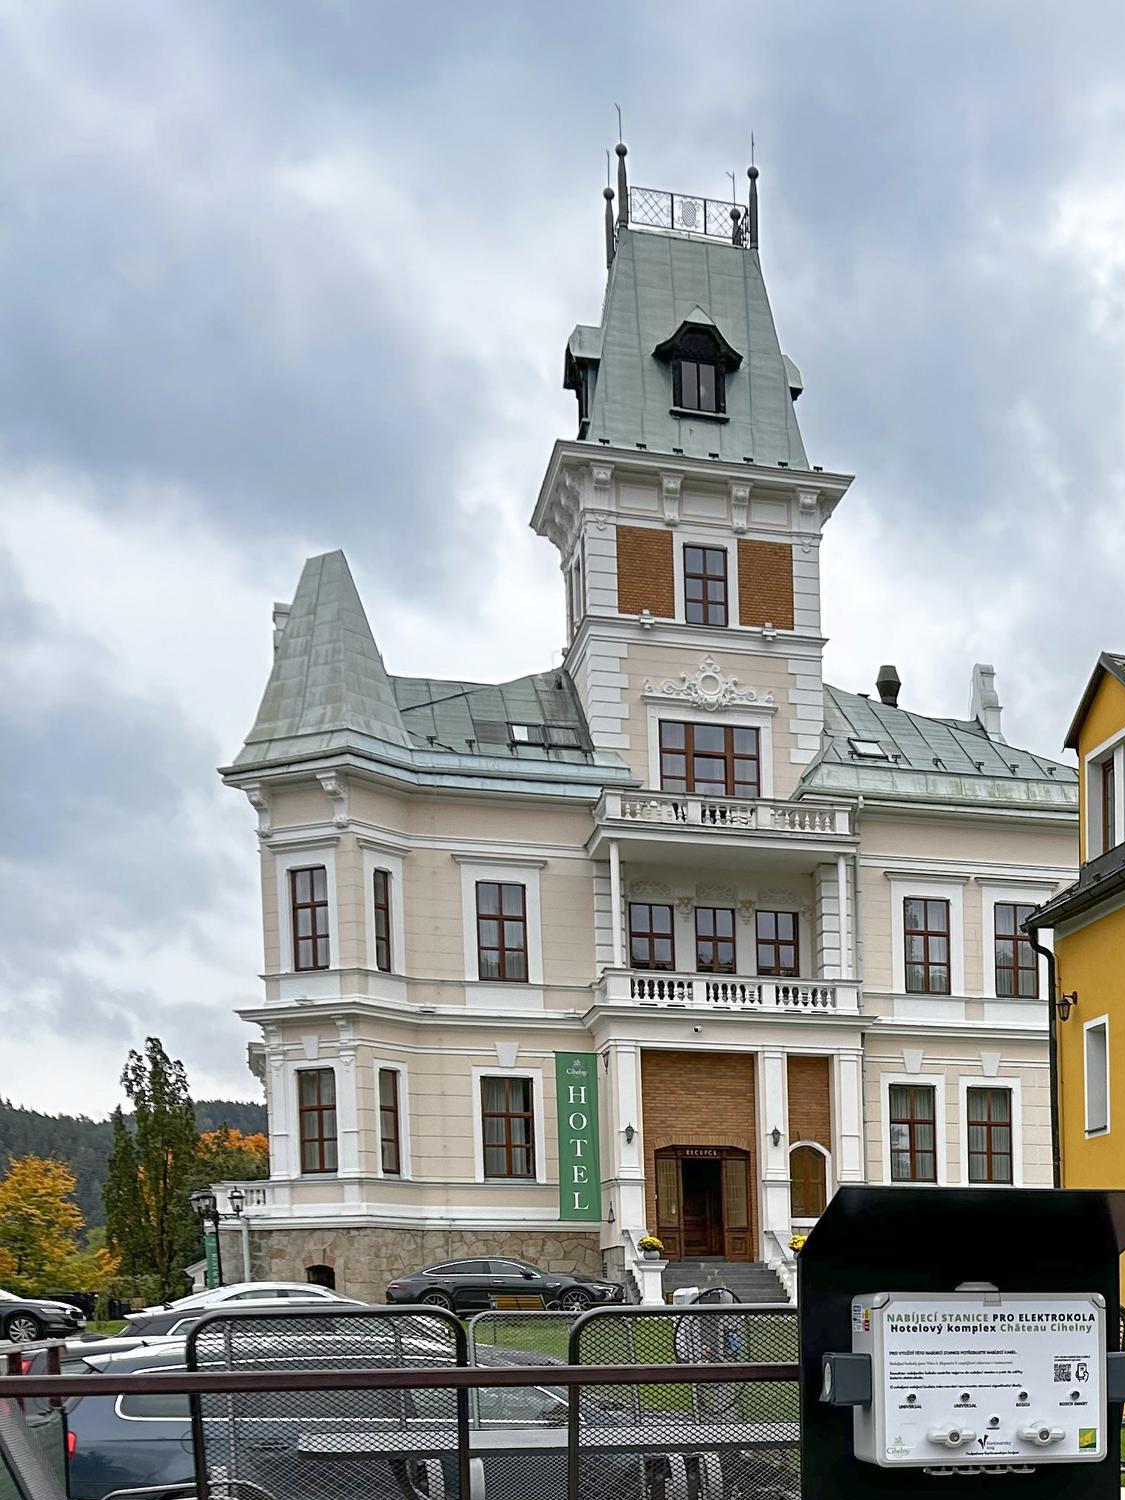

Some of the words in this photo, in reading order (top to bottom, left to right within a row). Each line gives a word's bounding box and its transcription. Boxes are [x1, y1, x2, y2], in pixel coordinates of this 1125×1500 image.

[567, 1086, 589, 1210] HOTEL
[886, 1312, 938, 1324] NABÍJECÍ
[941, 1313, 989, 1323] STANICE
[992, 1313, 1015, 1322] PRO
[1018, 1313, 1096, 1322] ELEKTROKOLA
[890, 1323, 943, 1335] Hotelový
[947, 1323, 997, 1334] komplex
[1000, 1322, 1047, 1333] Château
[1050, 1322, 1093, 1334] Cihelny
